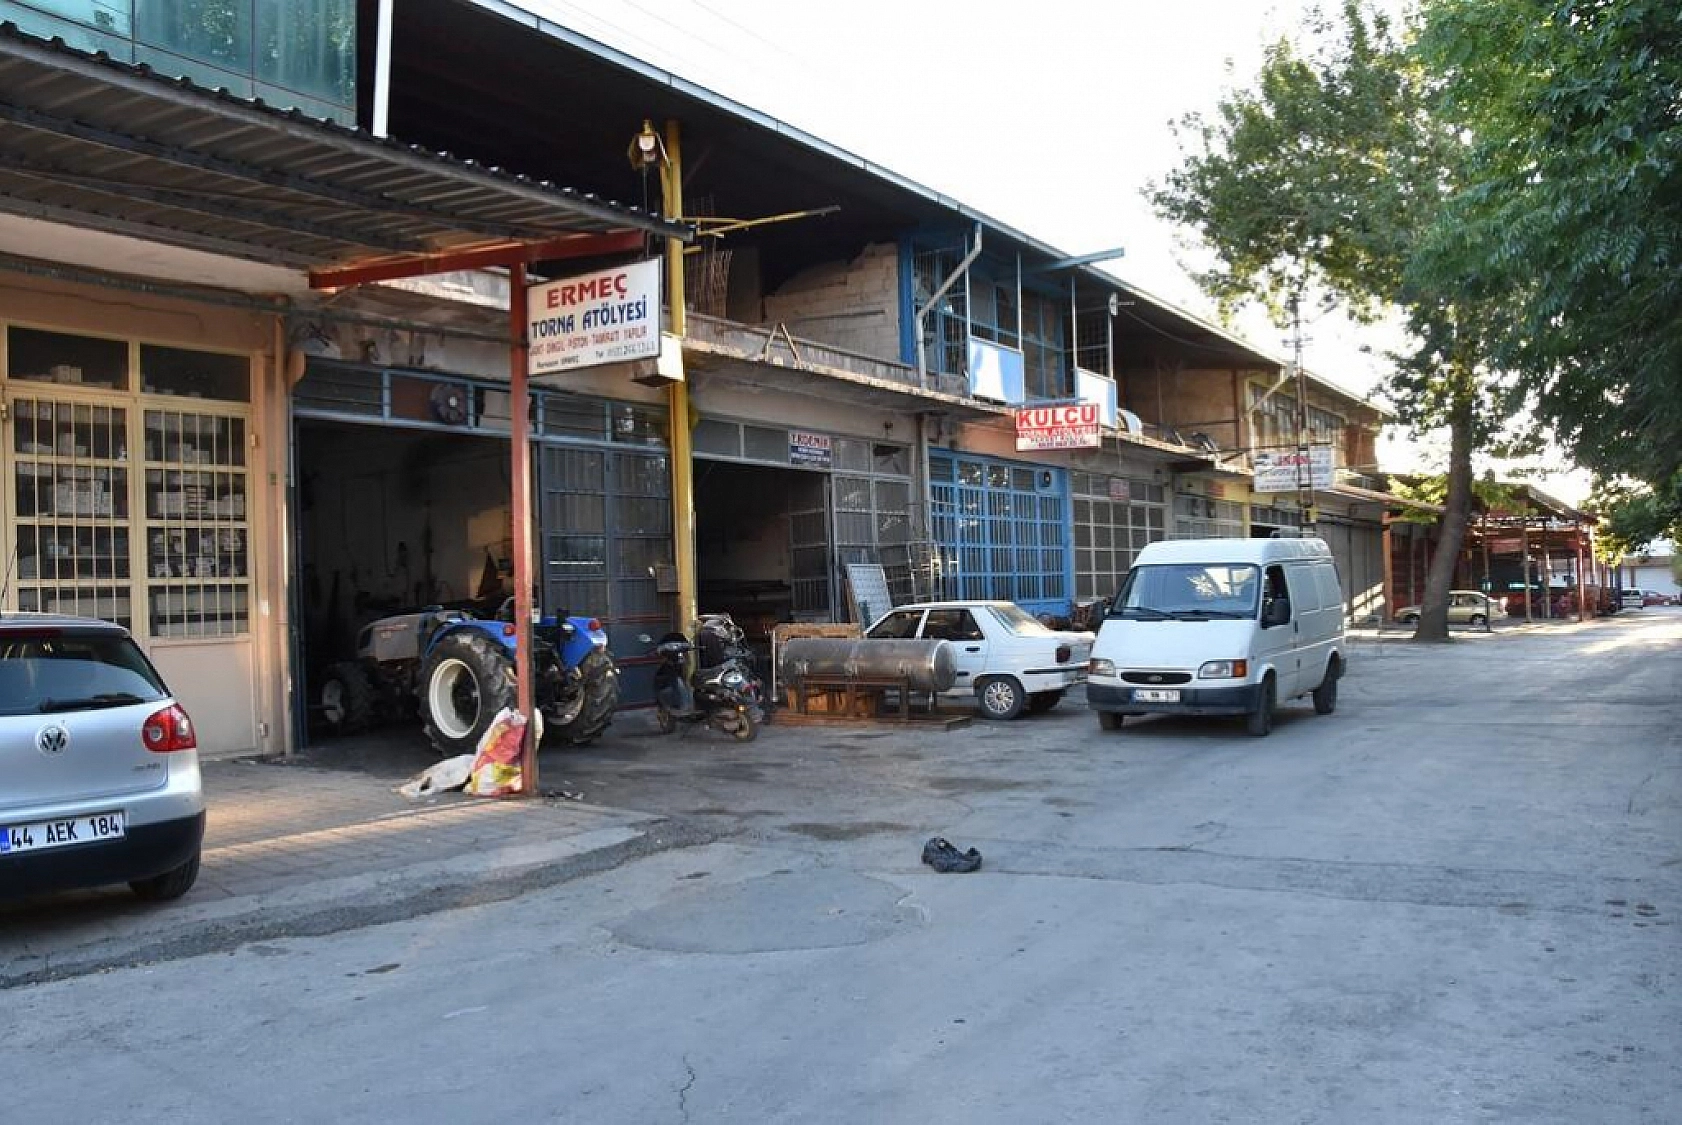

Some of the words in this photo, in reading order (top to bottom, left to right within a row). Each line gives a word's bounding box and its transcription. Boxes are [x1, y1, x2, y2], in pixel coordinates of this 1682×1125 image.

[547, 273, 628, 309] ERMEÇ
[531, 314, 575, 339] TORNA
[582, 294, 648, 331] ATÖLYESİ
[1019, 405, 1096, 427] KULCU
[11, 827, 33, 848] 44
[46, 821, 78, 844] AEK
[89, 816, 119, 837] 184
